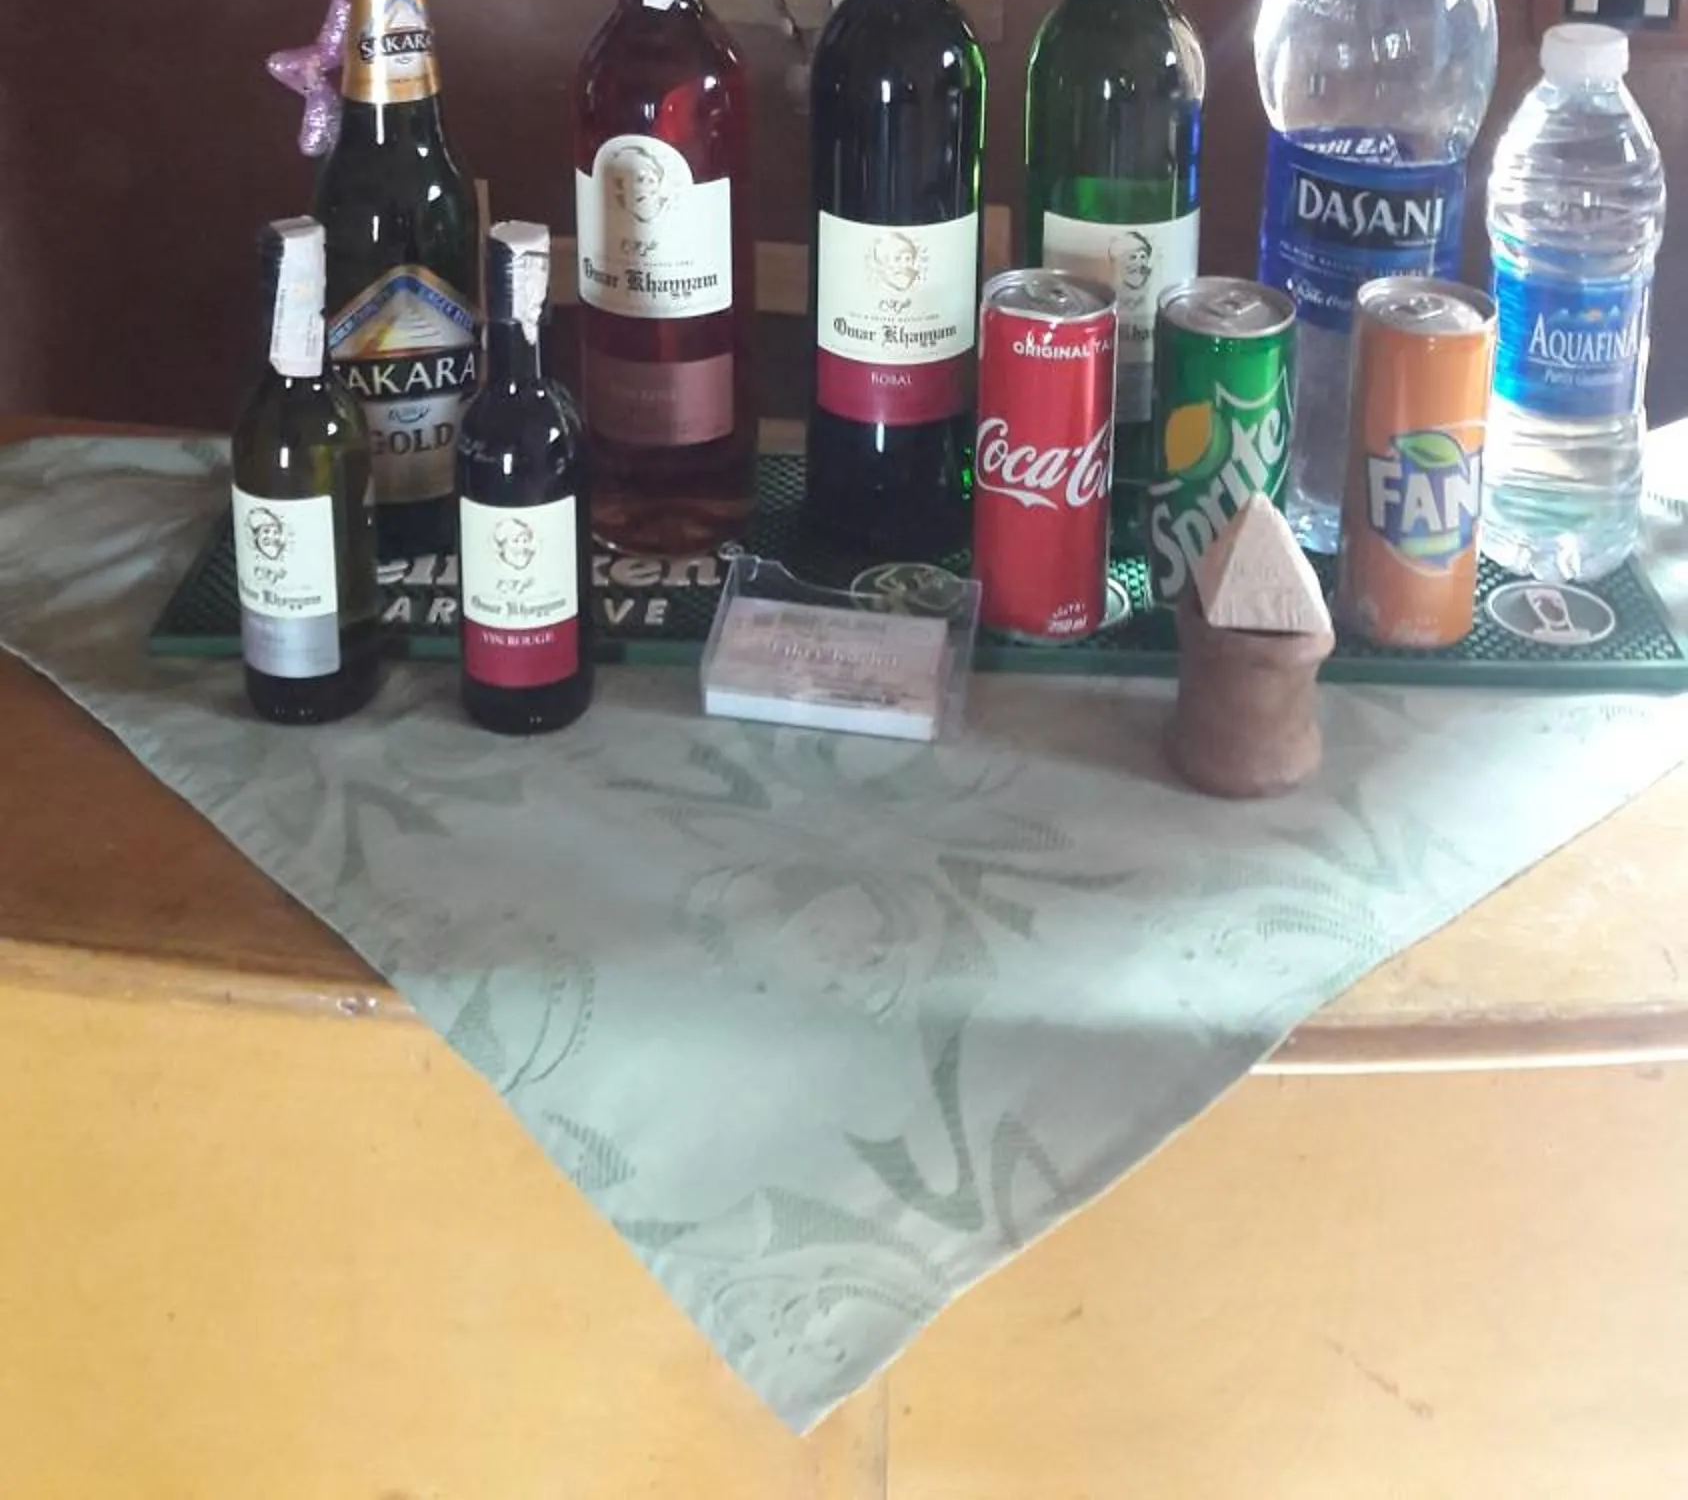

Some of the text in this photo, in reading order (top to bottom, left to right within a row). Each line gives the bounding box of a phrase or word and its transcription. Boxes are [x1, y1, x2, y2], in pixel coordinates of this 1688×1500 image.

[1298, 177, 1444, 237] DASANI
[583, 256, 718, 300] Omar Khayyam
[833, 316, 957, 349] Omar Khayyam
[1013, 340, 1091, 359] ORIGINAL
[1528, 311, 1640, 368] AQUAFINA
[346, 351, 477, 397] AKARA
